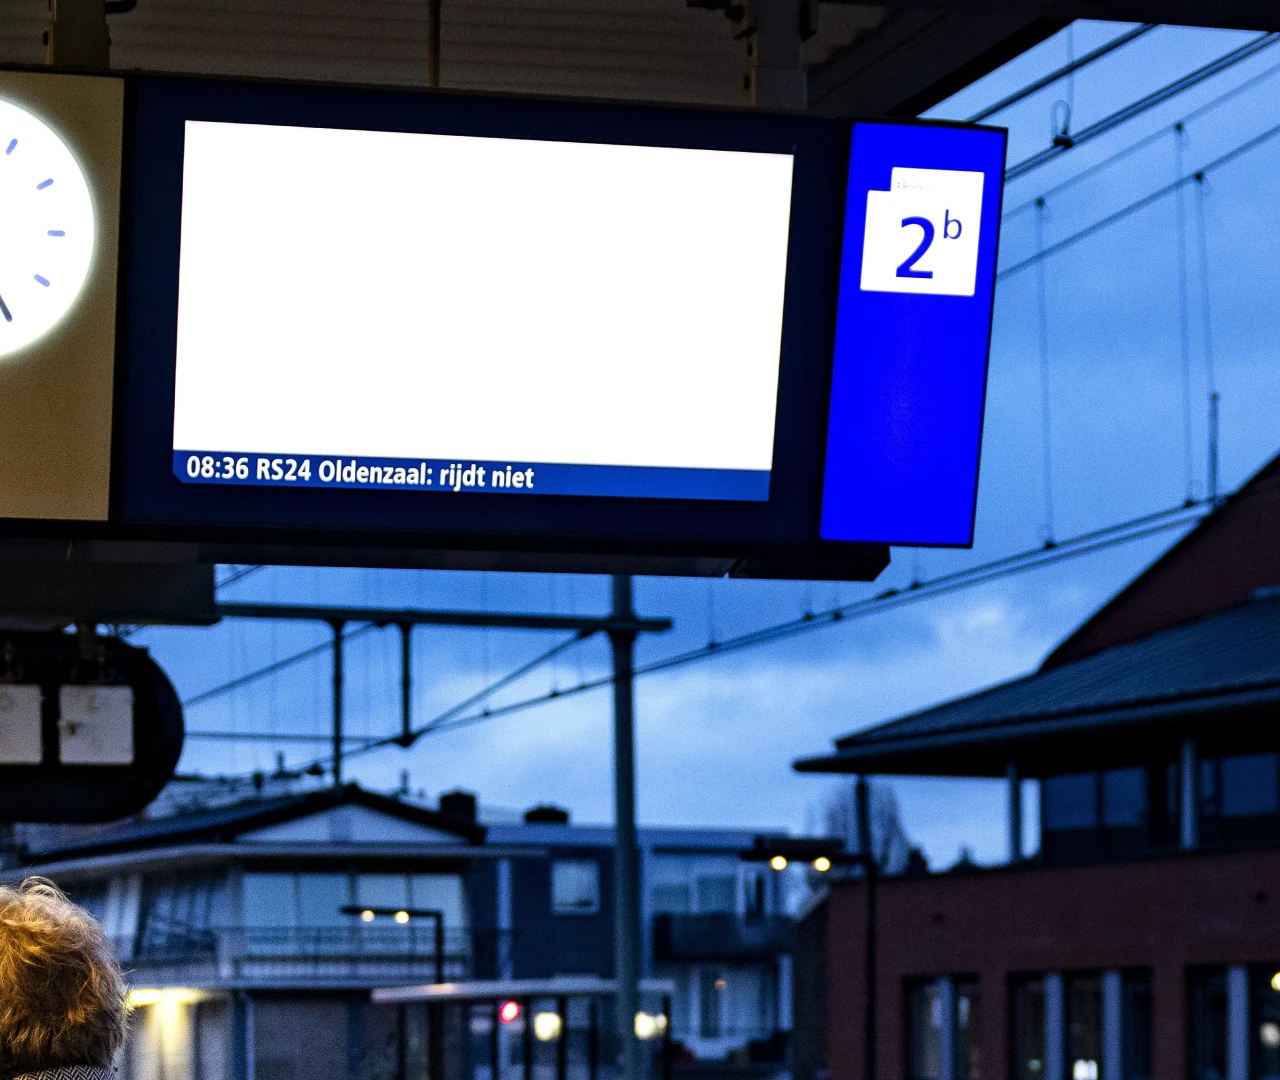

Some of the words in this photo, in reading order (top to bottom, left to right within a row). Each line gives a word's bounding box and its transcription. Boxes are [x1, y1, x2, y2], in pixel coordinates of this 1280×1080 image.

[186, 455, 249, 480] 08:36
[256, 457, 312, 482] RS24
[318, 459, 433, 486] Oldenzaal:
[439, 463, 486, 492] rijdt
[491, 465, 535, 489] niet
